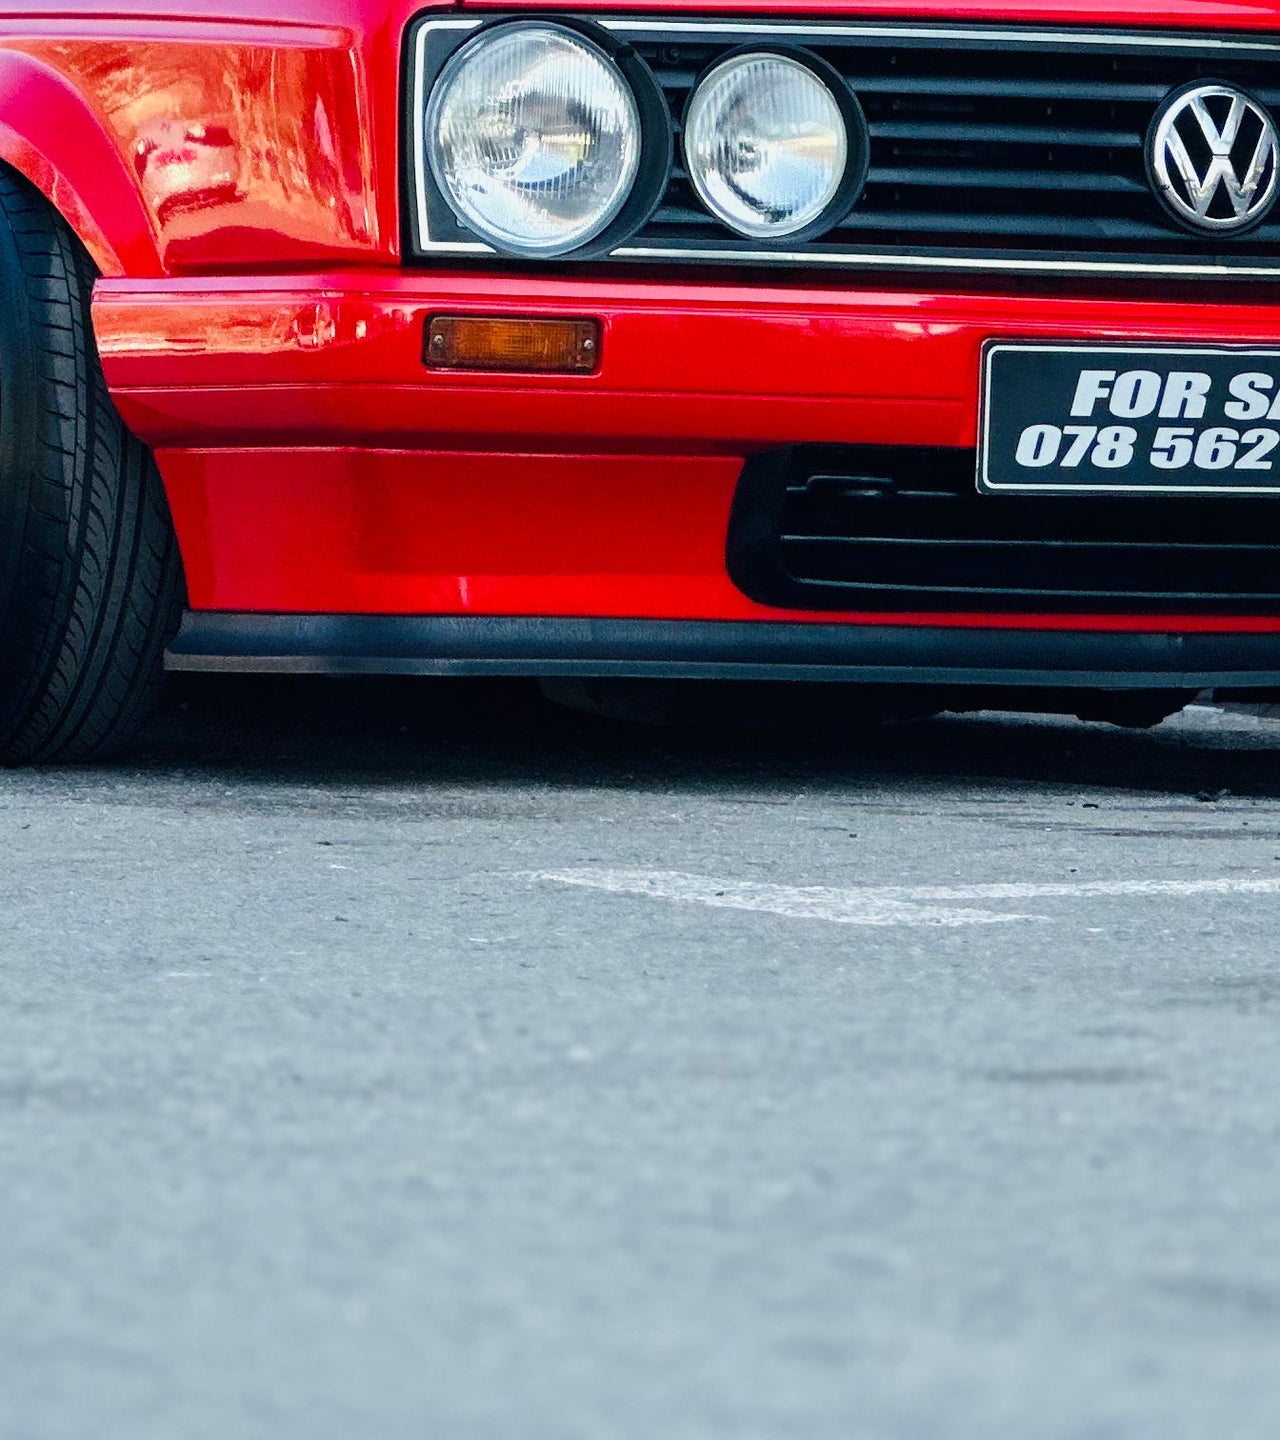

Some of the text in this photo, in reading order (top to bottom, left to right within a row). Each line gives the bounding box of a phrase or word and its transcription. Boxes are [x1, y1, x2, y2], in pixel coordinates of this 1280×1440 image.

[1156, 88, 1277, 225] VW
[1069, 369, 1213, 419] FOR
[1014, 424, 1138, 469] 078
[1148, 427, 1280, 471] 562
